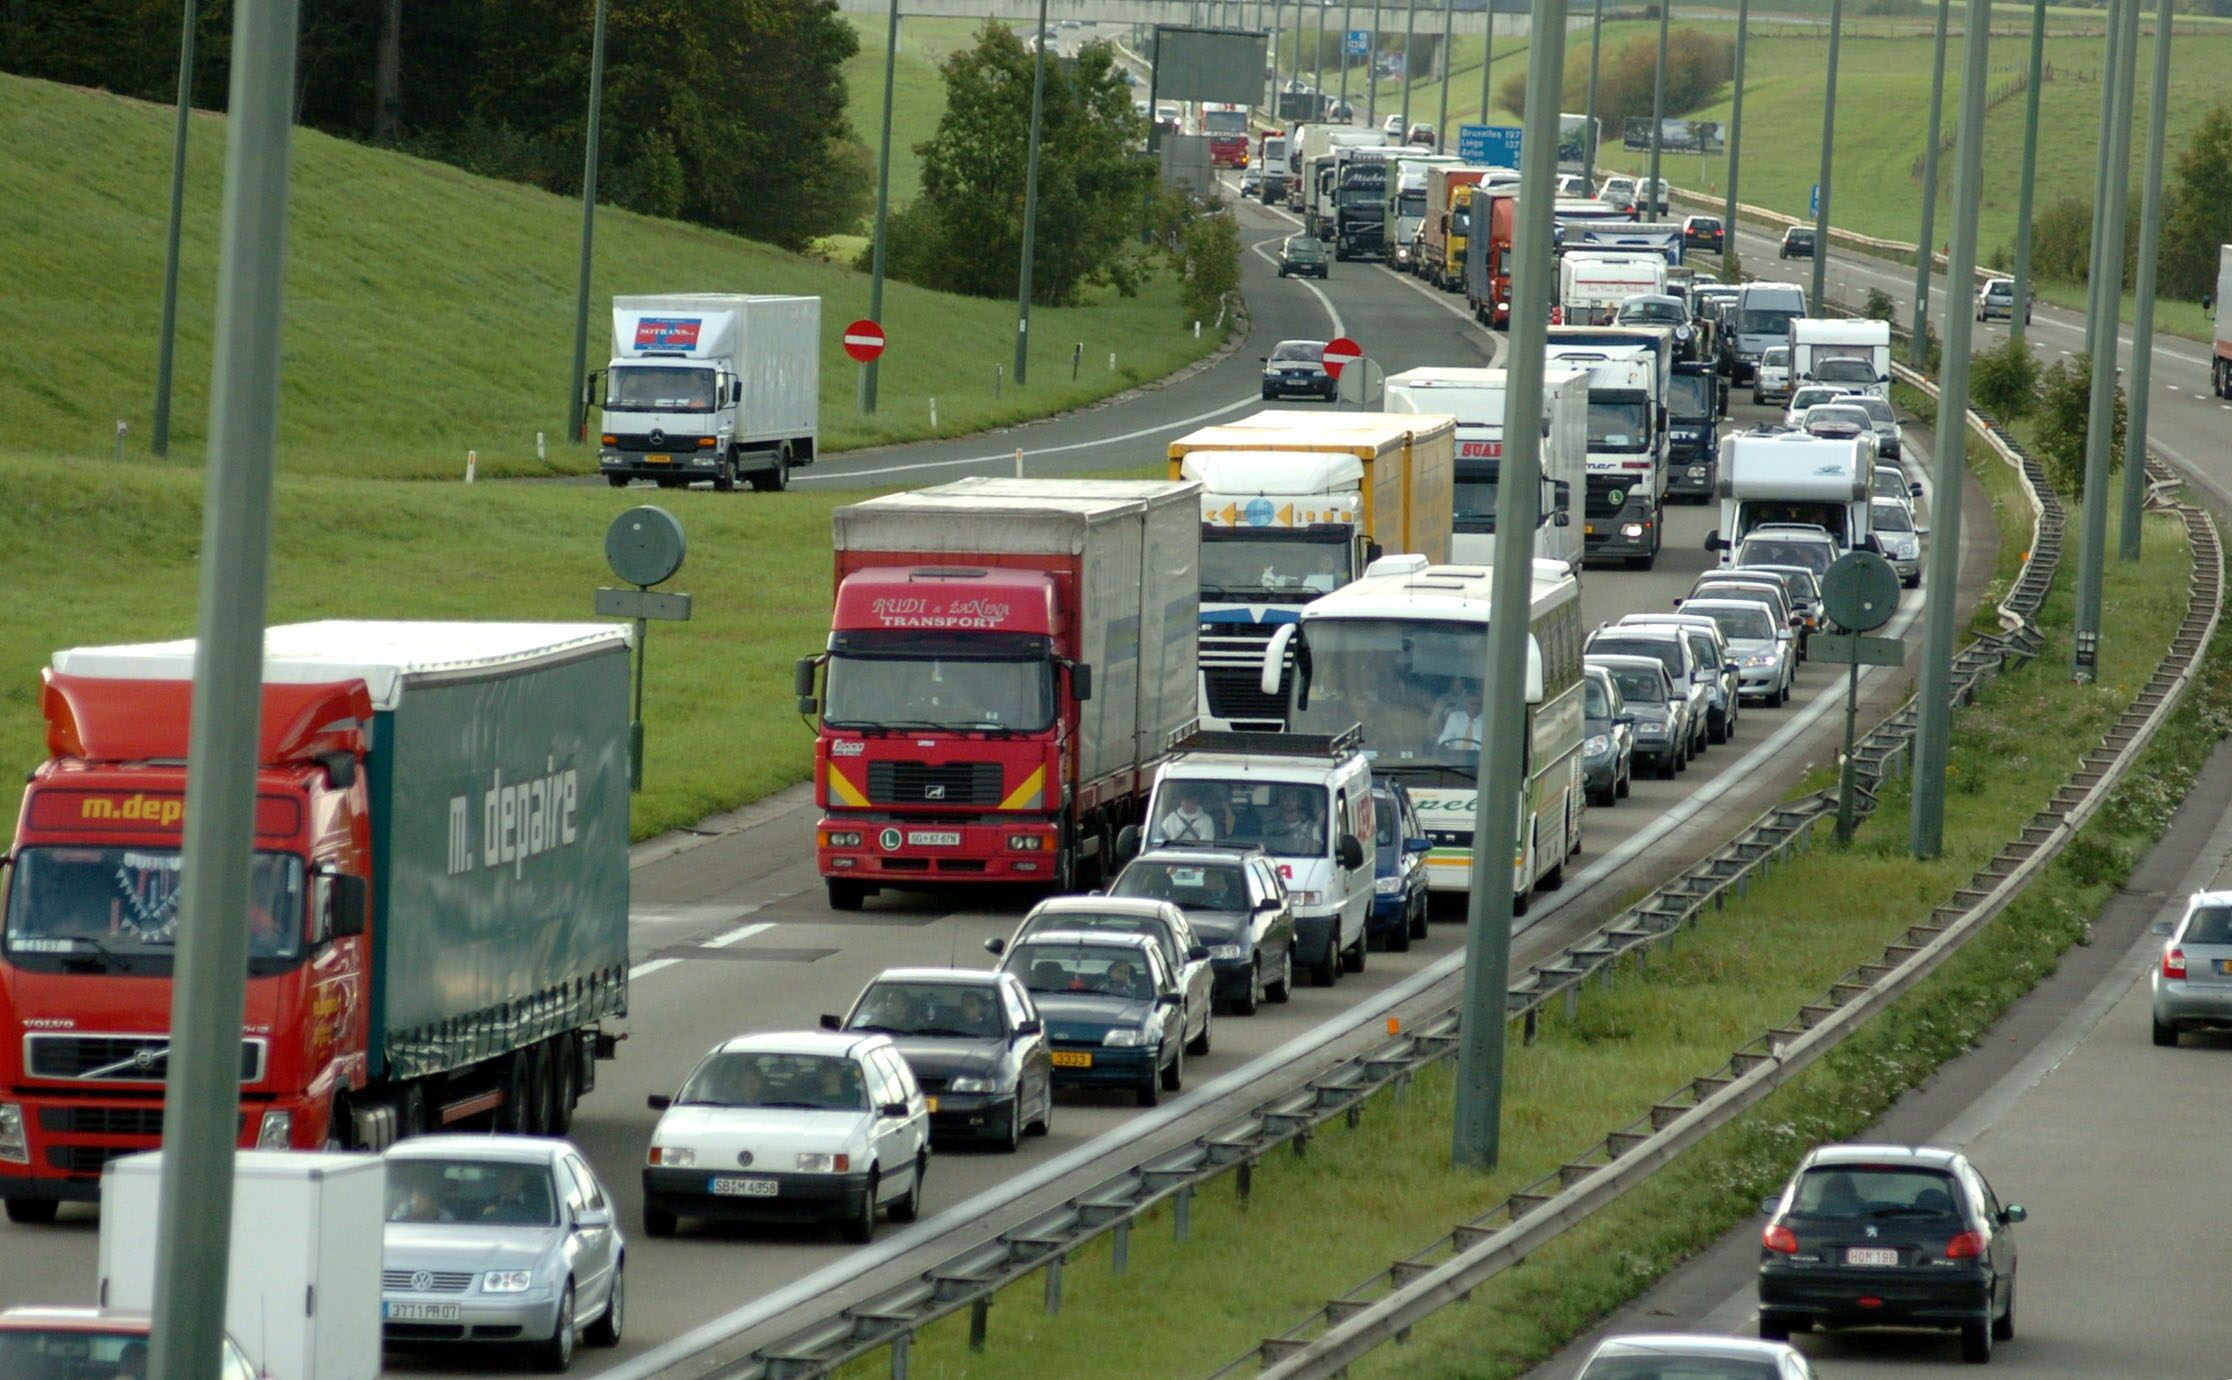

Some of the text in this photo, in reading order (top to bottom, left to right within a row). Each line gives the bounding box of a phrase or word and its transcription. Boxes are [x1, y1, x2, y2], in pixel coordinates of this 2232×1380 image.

[1462, 129, 1502, 139] Bruxelles
[1462, 139, 1484, 149] Liège
[1462, 149, 1484, 158] Arlon
[872, 598, 928, 619] RUDI
[882, 616, 1003, 628] TRANSPORT
[82, 794, 182, 826] m.dep
[485, 754, 577, 880] depaire
[22, 1019, 75, 1029] VOLVO
[1057, 1054, 1086, 1065] 3333
